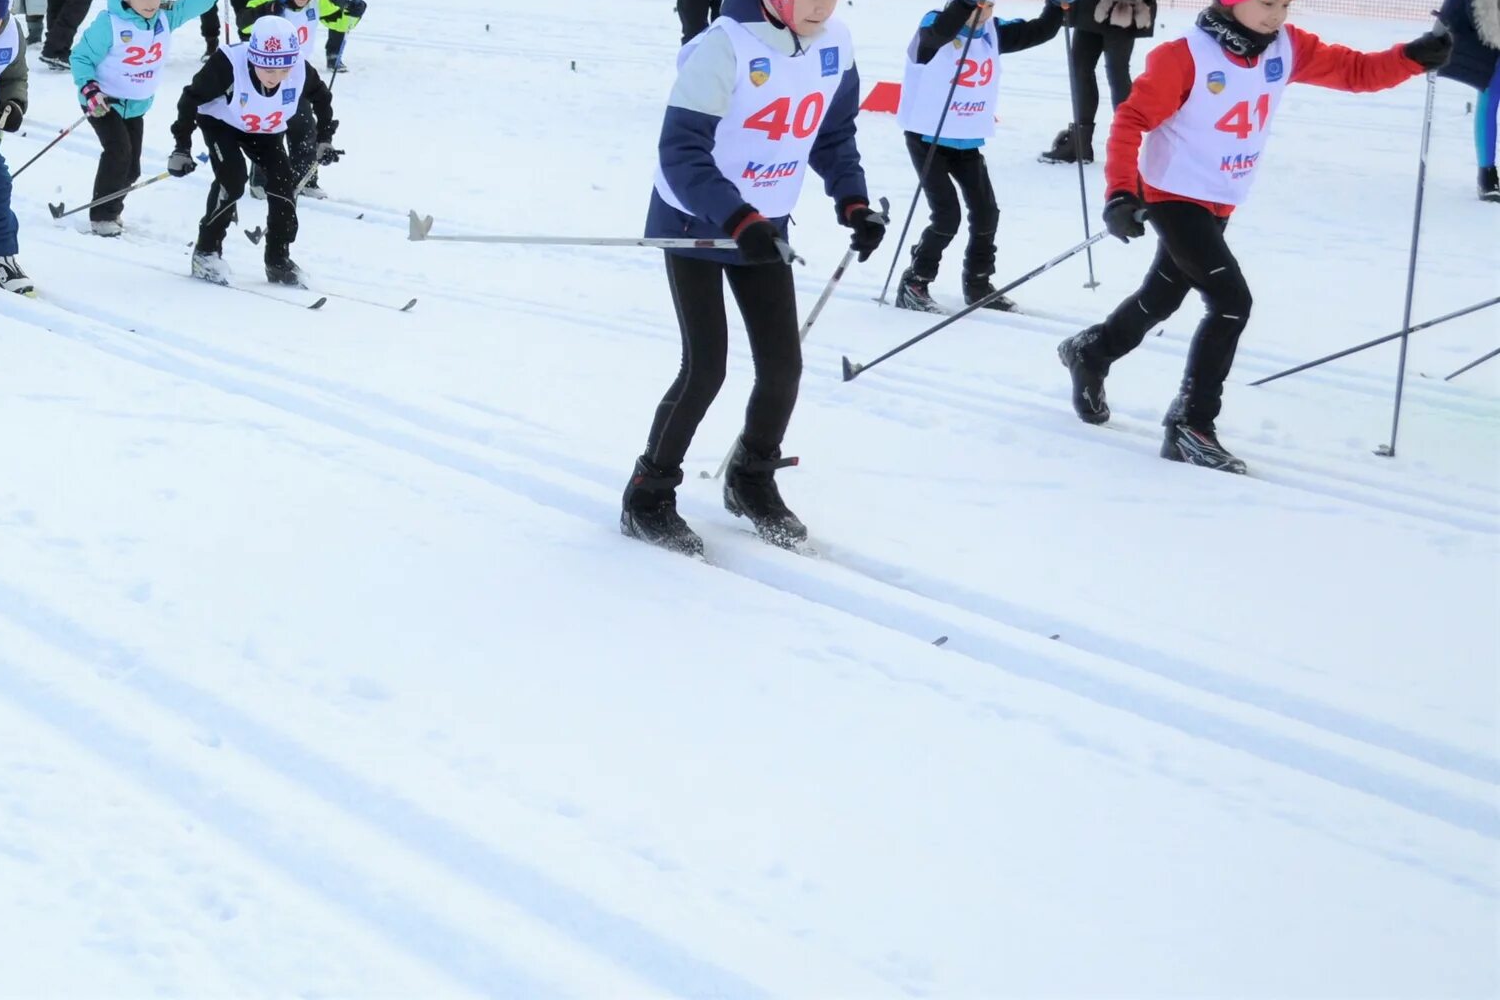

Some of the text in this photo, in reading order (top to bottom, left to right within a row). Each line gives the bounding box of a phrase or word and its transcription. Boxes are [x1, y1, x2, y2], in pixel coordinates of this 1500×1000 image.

[121, 42, 162, 66] 23
[248, 53, 285, 66] ЫЖНЯ
[950, 58, 993, 87] 29
[743, 92, 824, 141] 40
[1214, 94, 1270, 139] 41
